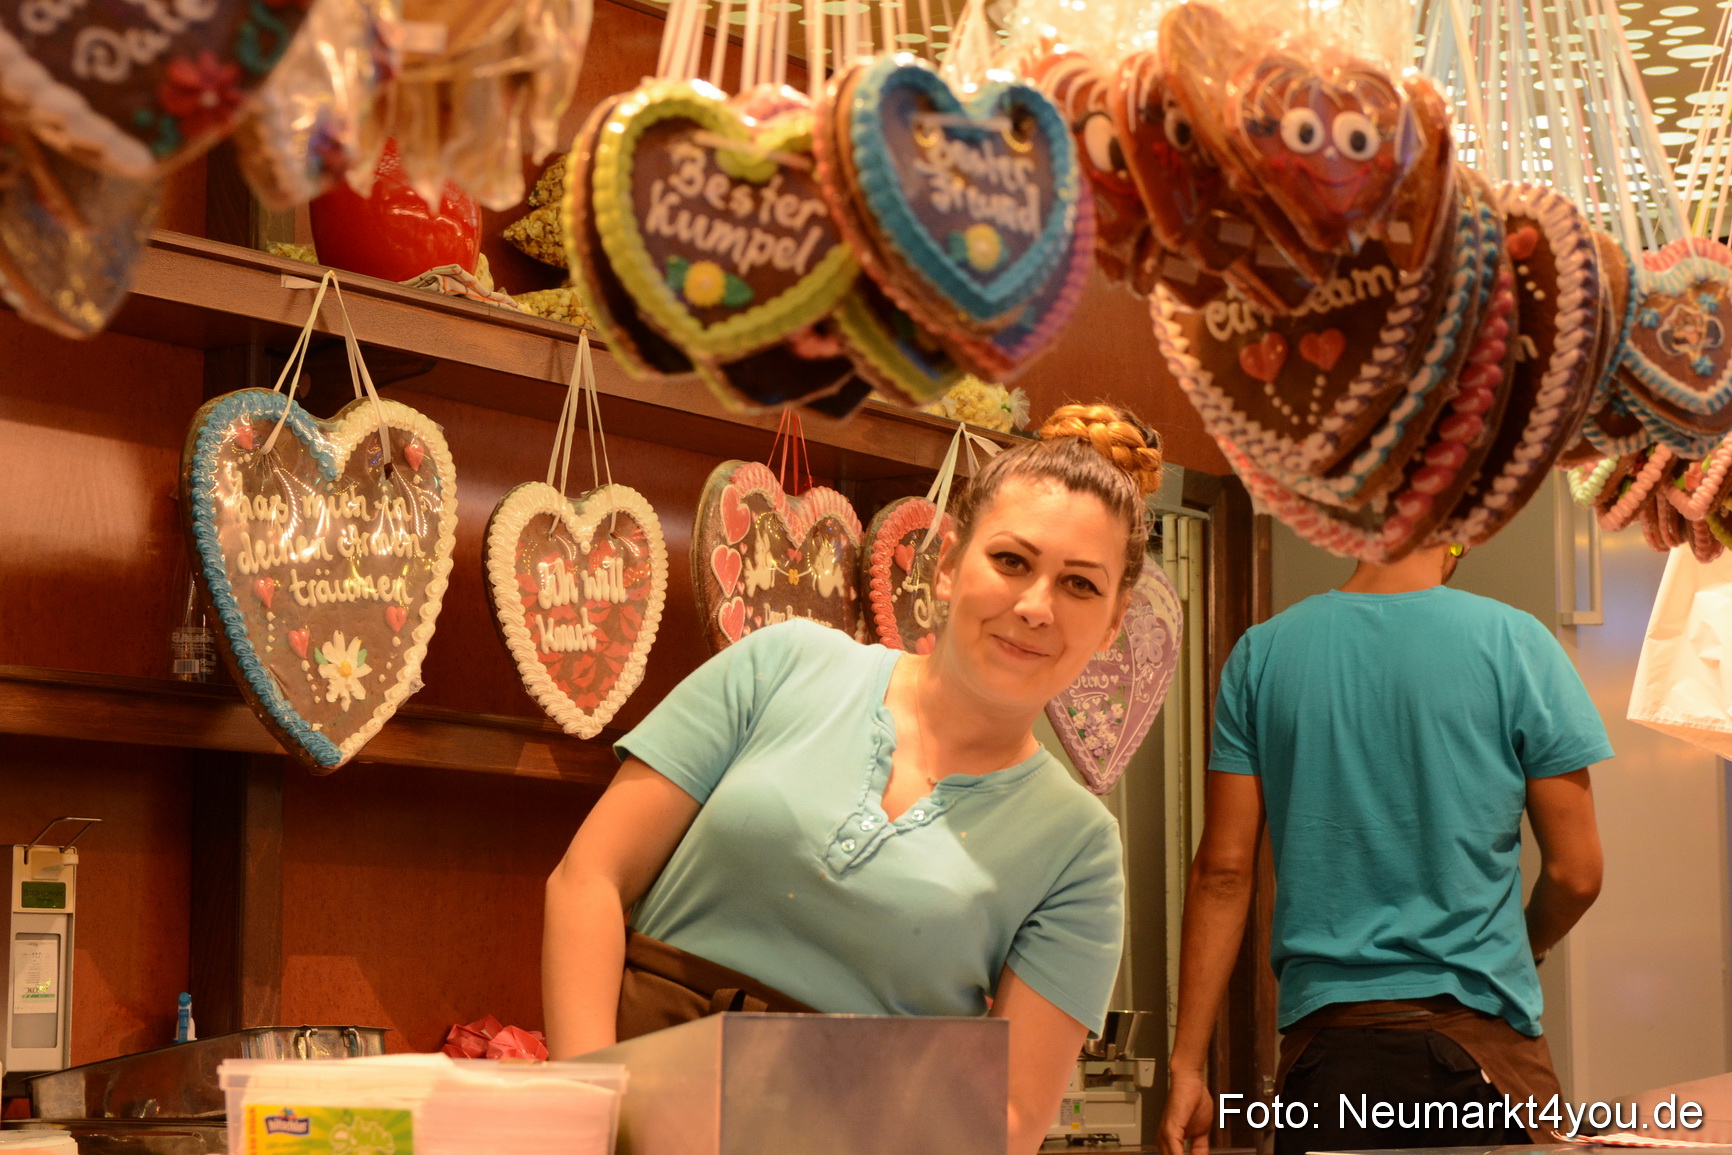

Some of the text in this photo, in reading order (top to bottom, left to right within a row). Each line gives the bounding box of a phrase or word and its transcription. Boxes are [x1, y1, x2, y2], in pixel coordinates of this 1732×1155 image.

[668, 143, 828, 230] Bester
[645, 178, 823, 276] Kumpel
[1290, 264, 1396, 317] eam
[301, 485, 371, 522] mich
[373, 494, 412, 522] in
[237, 530, 333, 575] deinen
[288, 568, 414, 607] träumen
[580, 555, 627, 604] will
